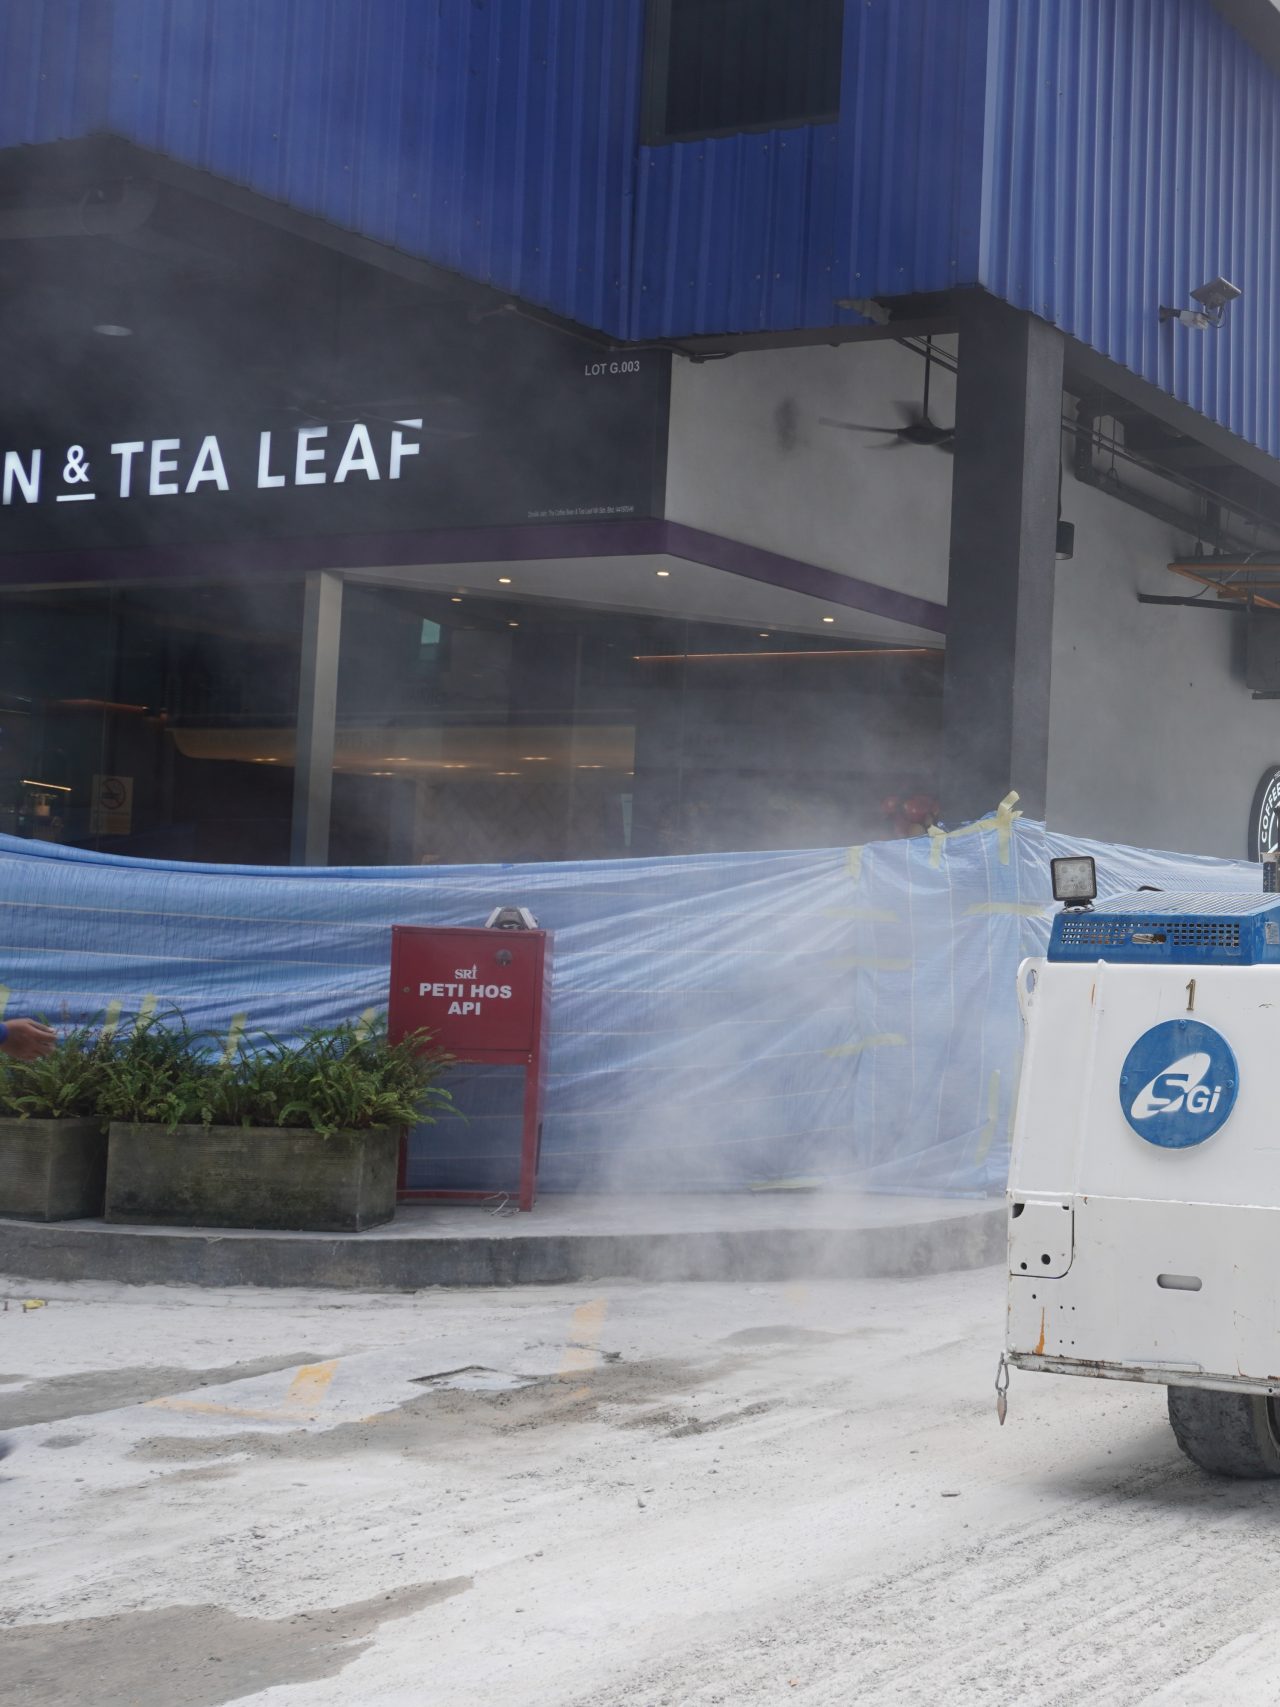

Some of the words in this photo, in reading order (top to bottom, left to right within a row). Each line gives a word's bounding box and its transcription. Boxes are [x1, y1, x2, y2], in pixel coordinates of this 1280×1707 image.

[584, 363, 607, 376] LOT
[609, 360, 640, 374] G.003
[2, 449, 42, 505] N
[62, 444, 91, 485] &
[111, 435, 230, 498] TEA
[256, 418, 424, 489] LEAF
[419, 982, 464, 997] PETI
[470, 984, 512, 999] HOS
[1185, 978, 1197, 1011] 1
[447, 1002, 481, 1015] API
